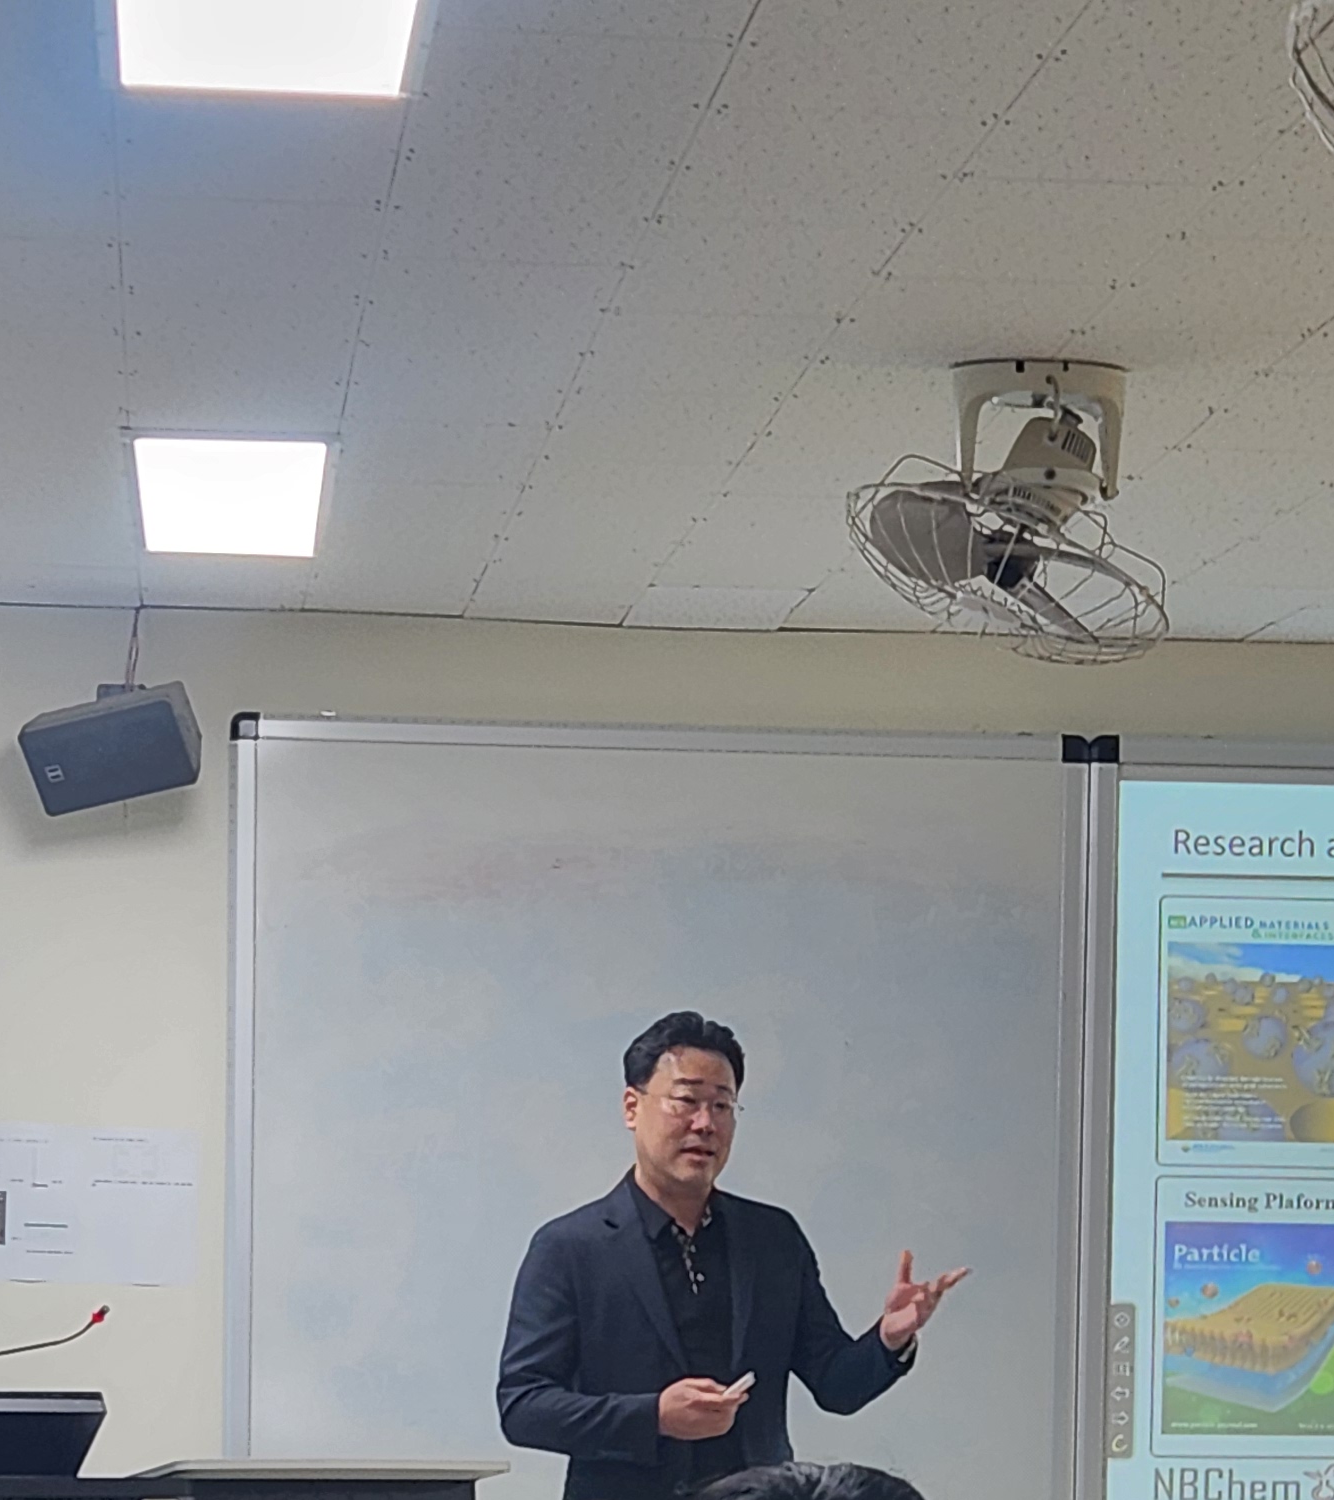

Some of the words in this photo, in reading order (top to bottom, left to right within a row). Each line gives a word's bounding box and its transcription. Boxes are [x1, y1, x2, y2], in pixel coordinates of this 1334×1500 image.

[1173, 828, 1316, 858] Research
[1188, 916, 1254, 929] APPLIED
[1185, 1191, 1259, 1213] Sensing
[1174, 1244, 1260, 1263] Particle
